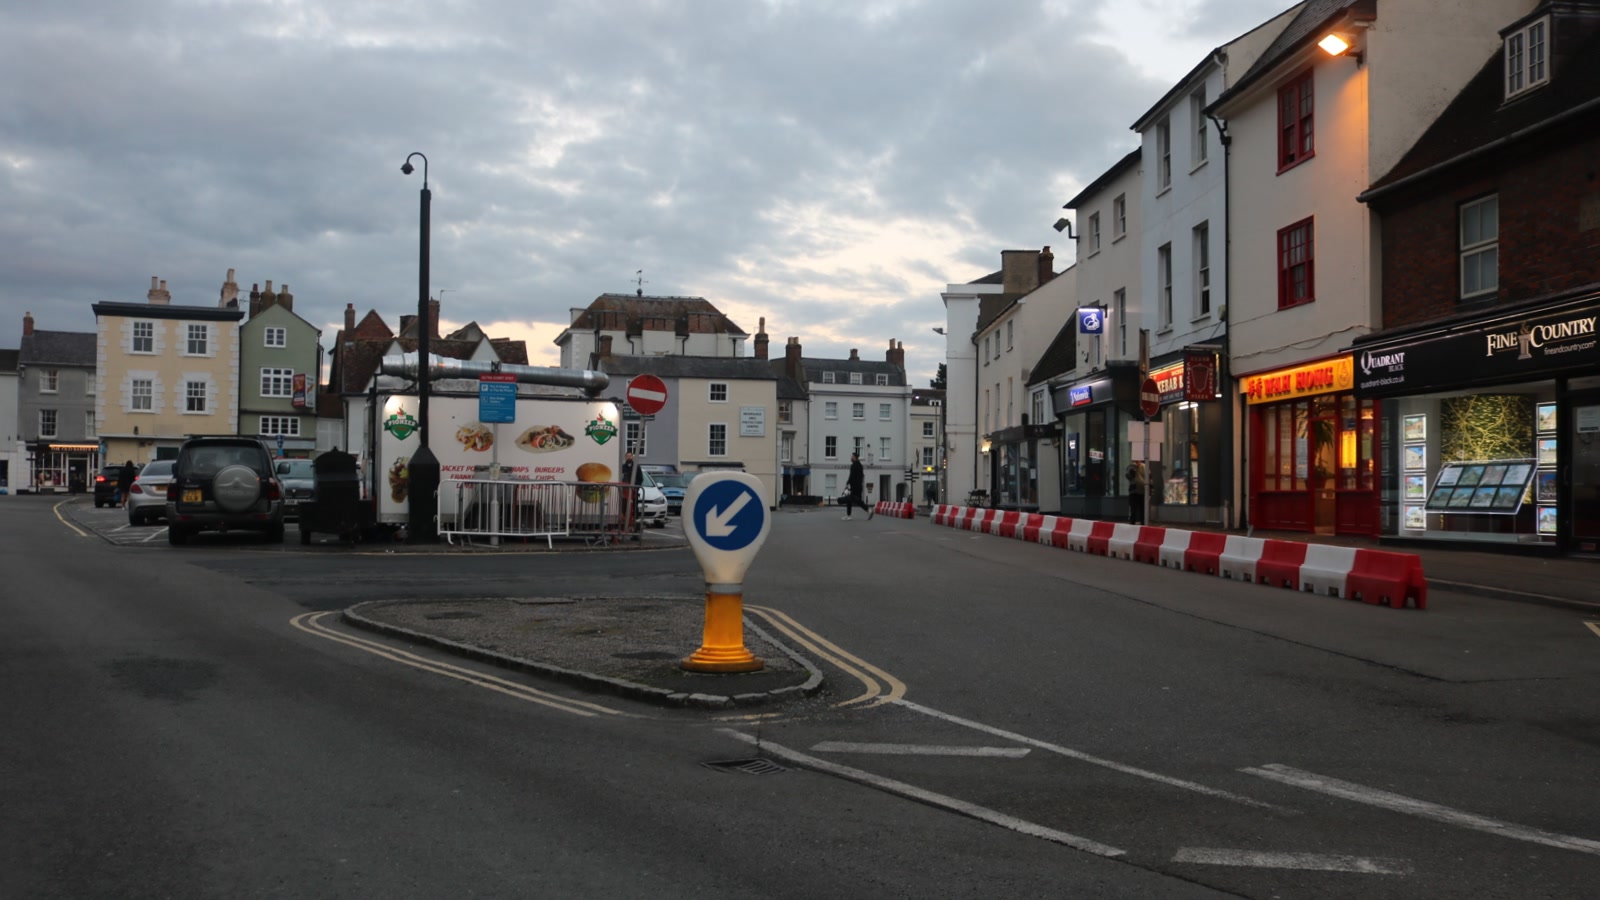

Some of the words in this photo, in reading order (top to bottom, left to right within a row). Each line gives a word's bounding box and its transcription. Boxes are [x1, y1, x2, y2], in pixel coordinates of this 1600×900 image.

[1486, 331, 1518, 357] FINE
[1530, 316, 1597, 348] COUNTRY
[1360, 350, 1405, 375] QUADRANT
[1388, 364, 1404, 372] BLACK
[388, 419, 416, 427] PIONEER
[588, 424, 614, 432] PIONEER
